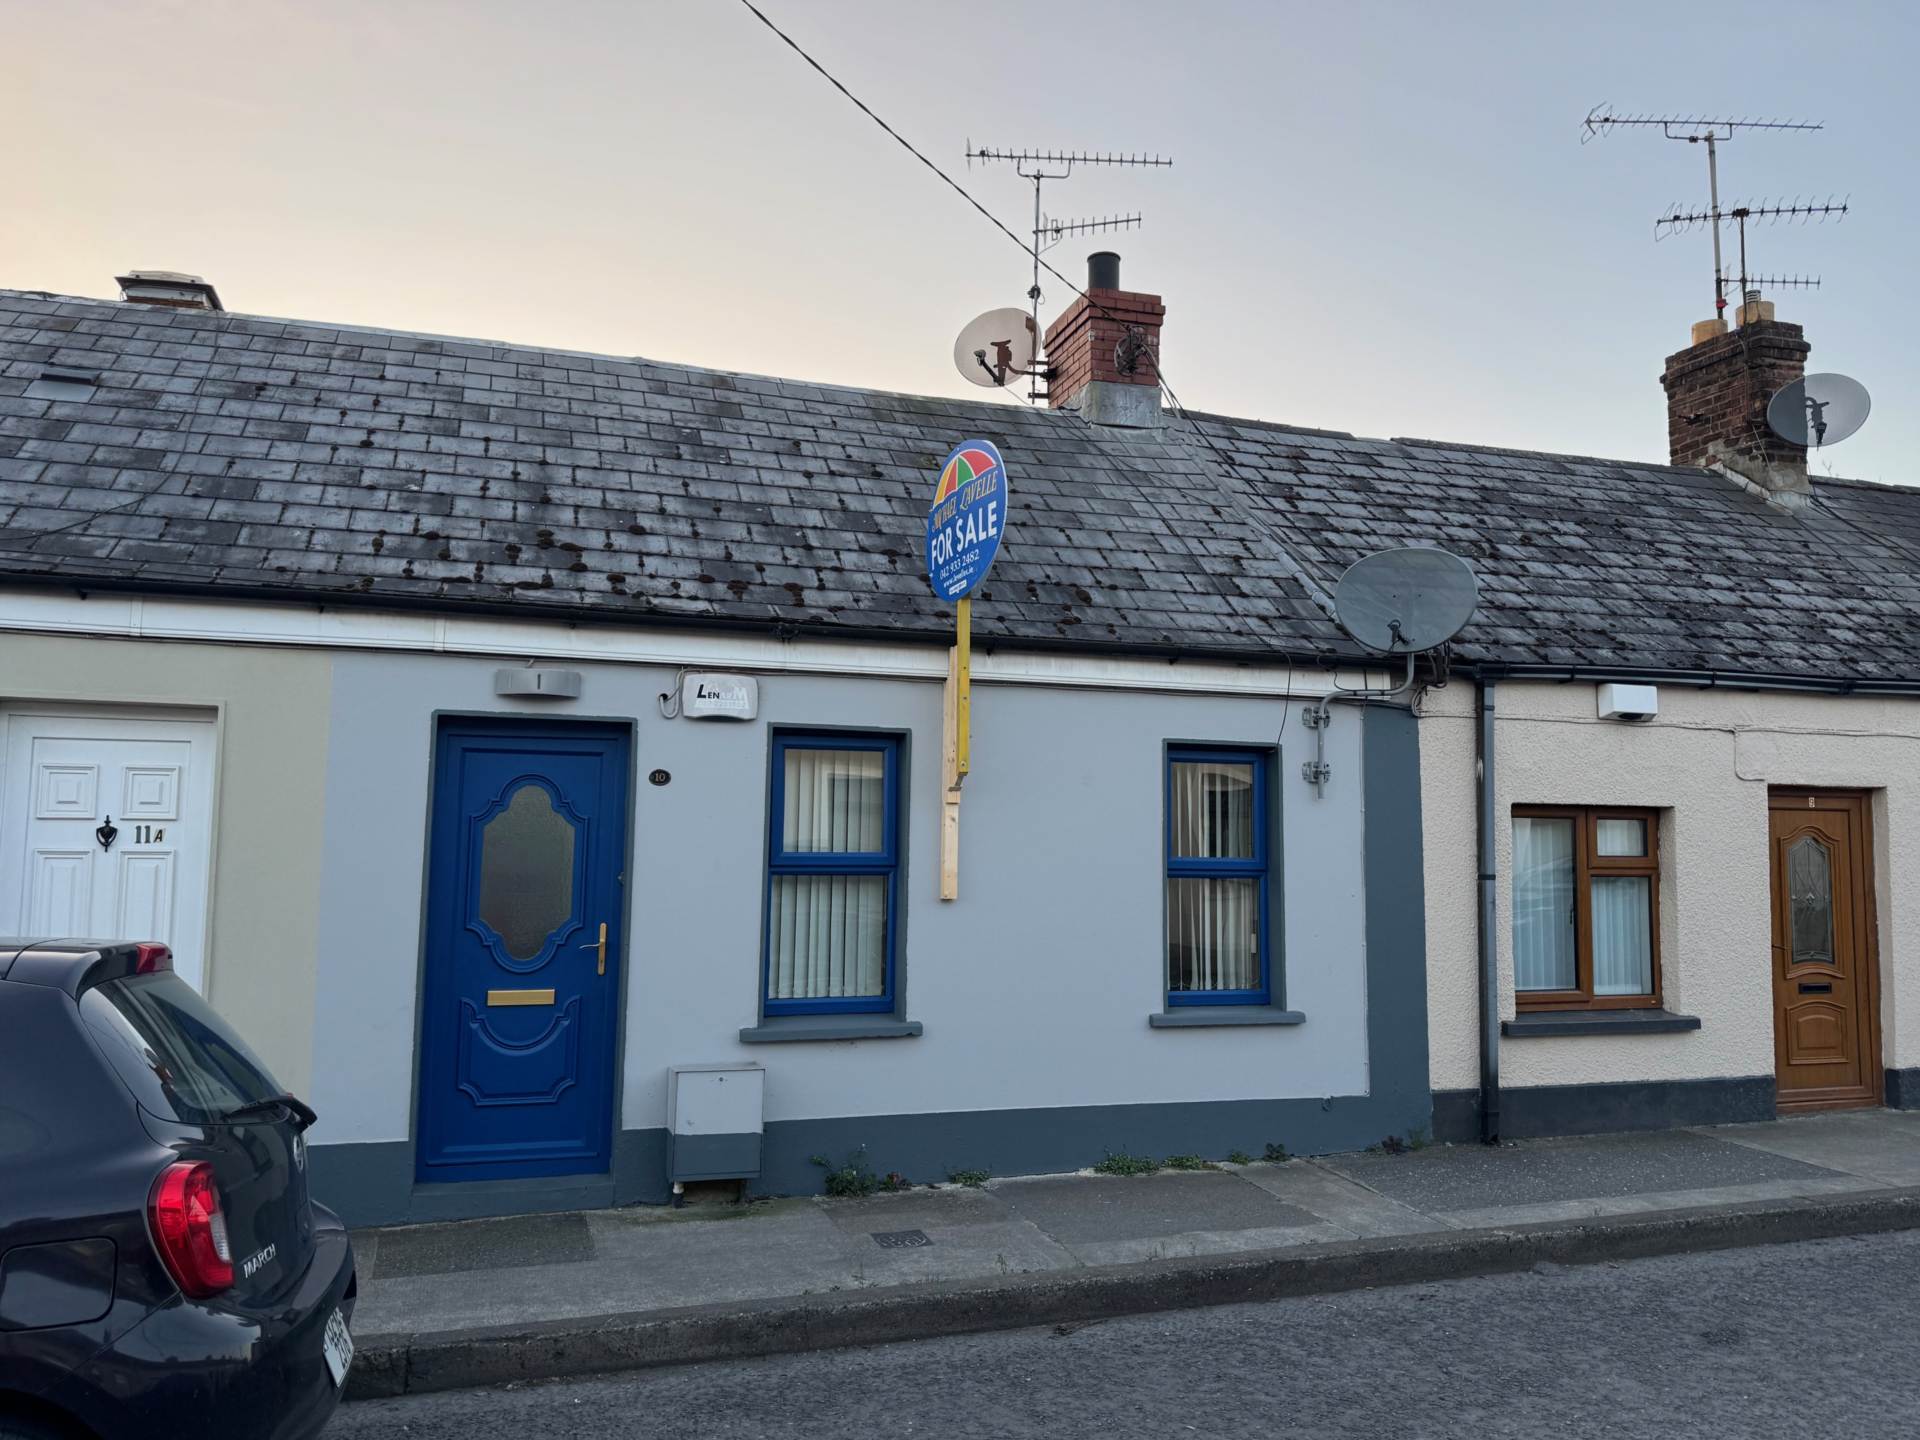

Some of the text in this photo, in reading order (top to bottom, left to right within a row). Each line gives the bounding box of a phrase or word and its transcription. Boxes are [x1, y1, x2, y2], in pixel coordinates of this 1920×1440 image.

[960, 470, 998, 511] LAVELLE
[931, 501, 998, 570] FOR SALE
[655, 772, 666, 782] 10
[135, 825, 163, 844] 11A
[243, 1243, 276, 1278] MARCH
